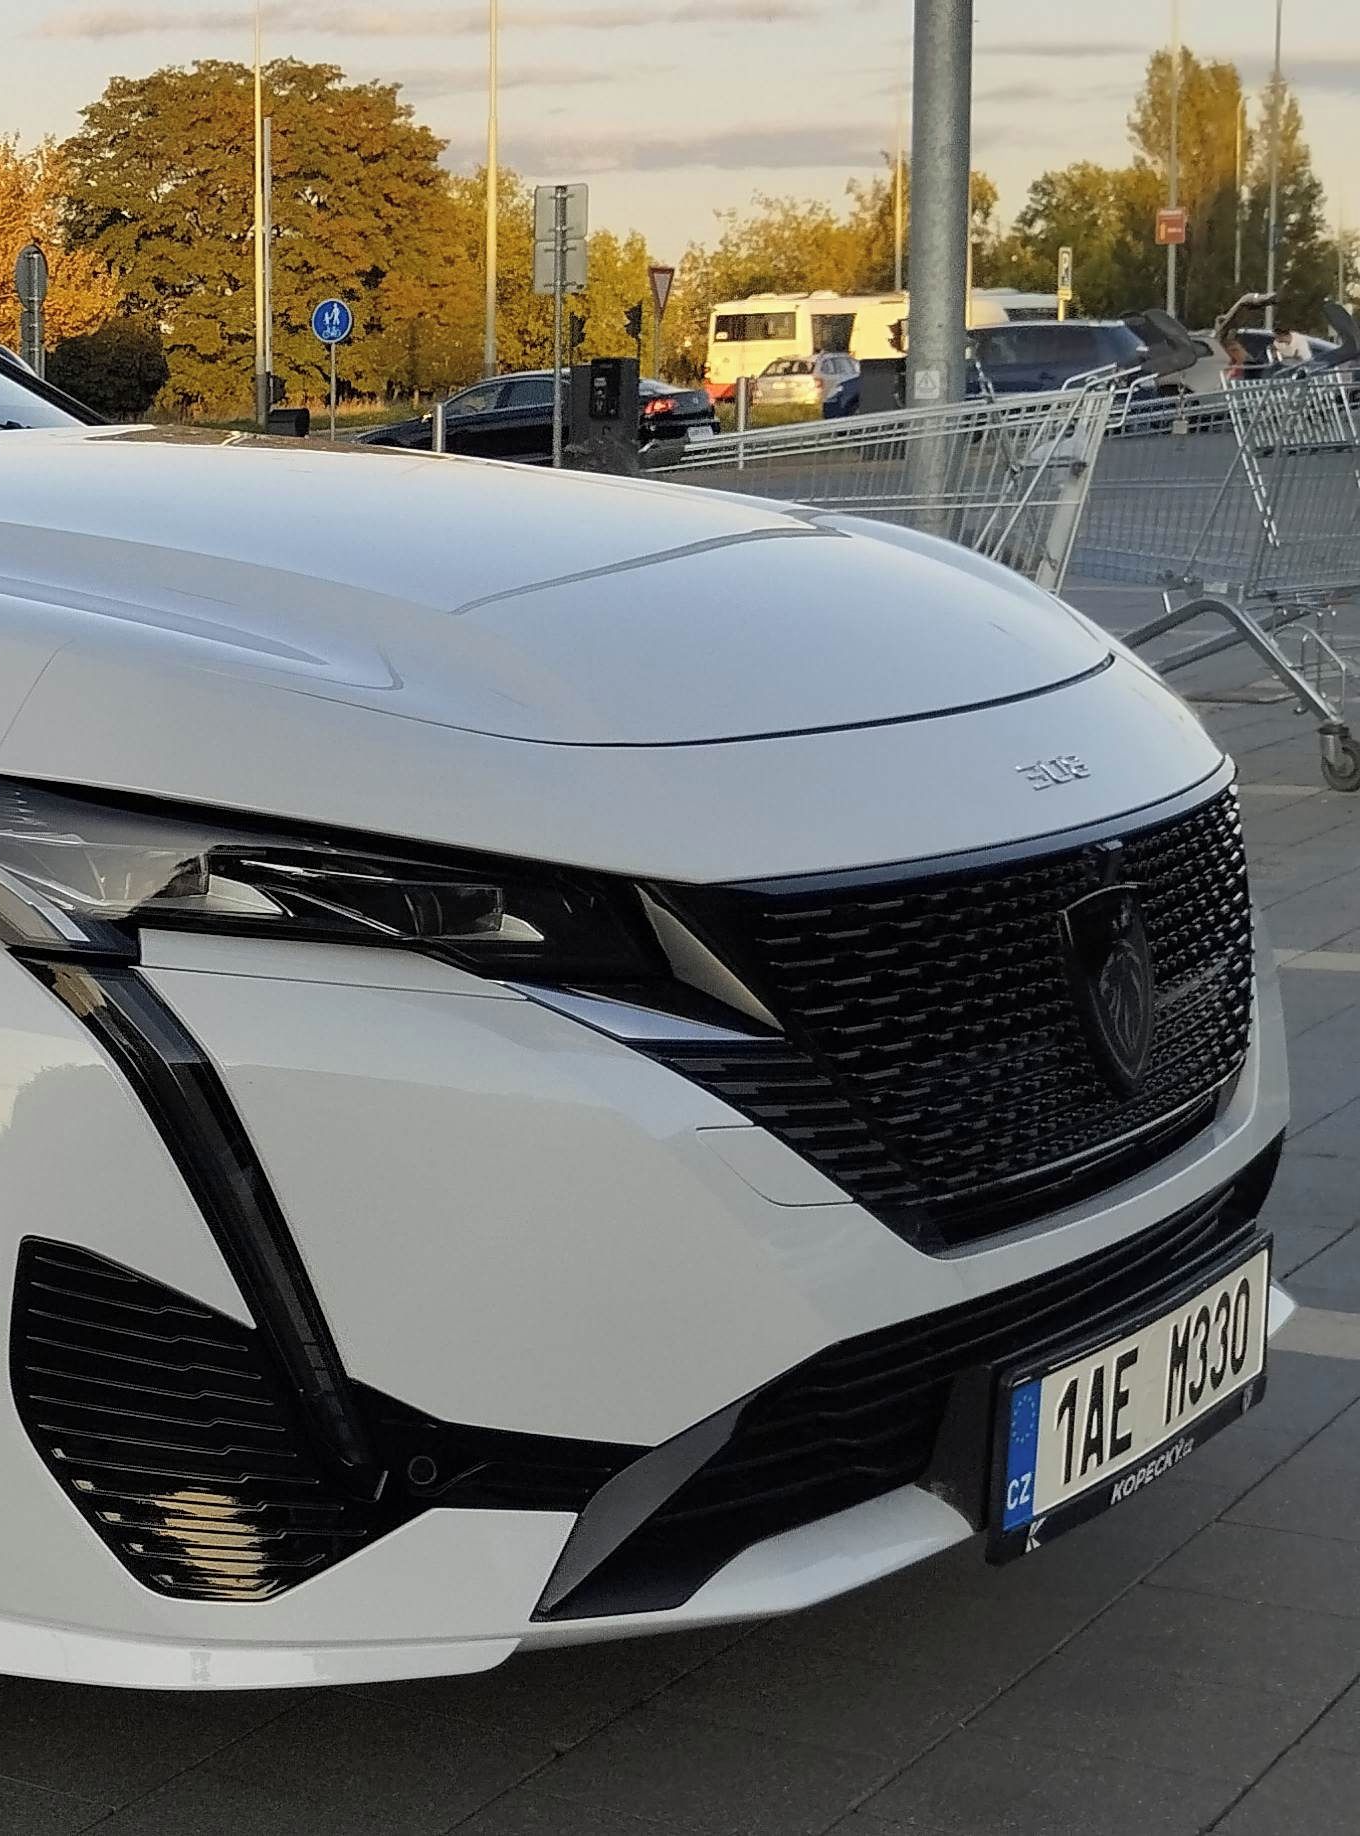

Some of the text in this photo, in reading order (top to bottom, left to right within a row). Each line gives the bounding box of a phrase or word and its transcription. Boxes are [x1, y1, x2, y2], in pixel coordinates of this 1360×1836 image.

[1015, 755, 1091, 791] 308
[1055, 1277, 1251, 1485] 1AE M330
[1006, 1472, 1032, 1511] CZ
